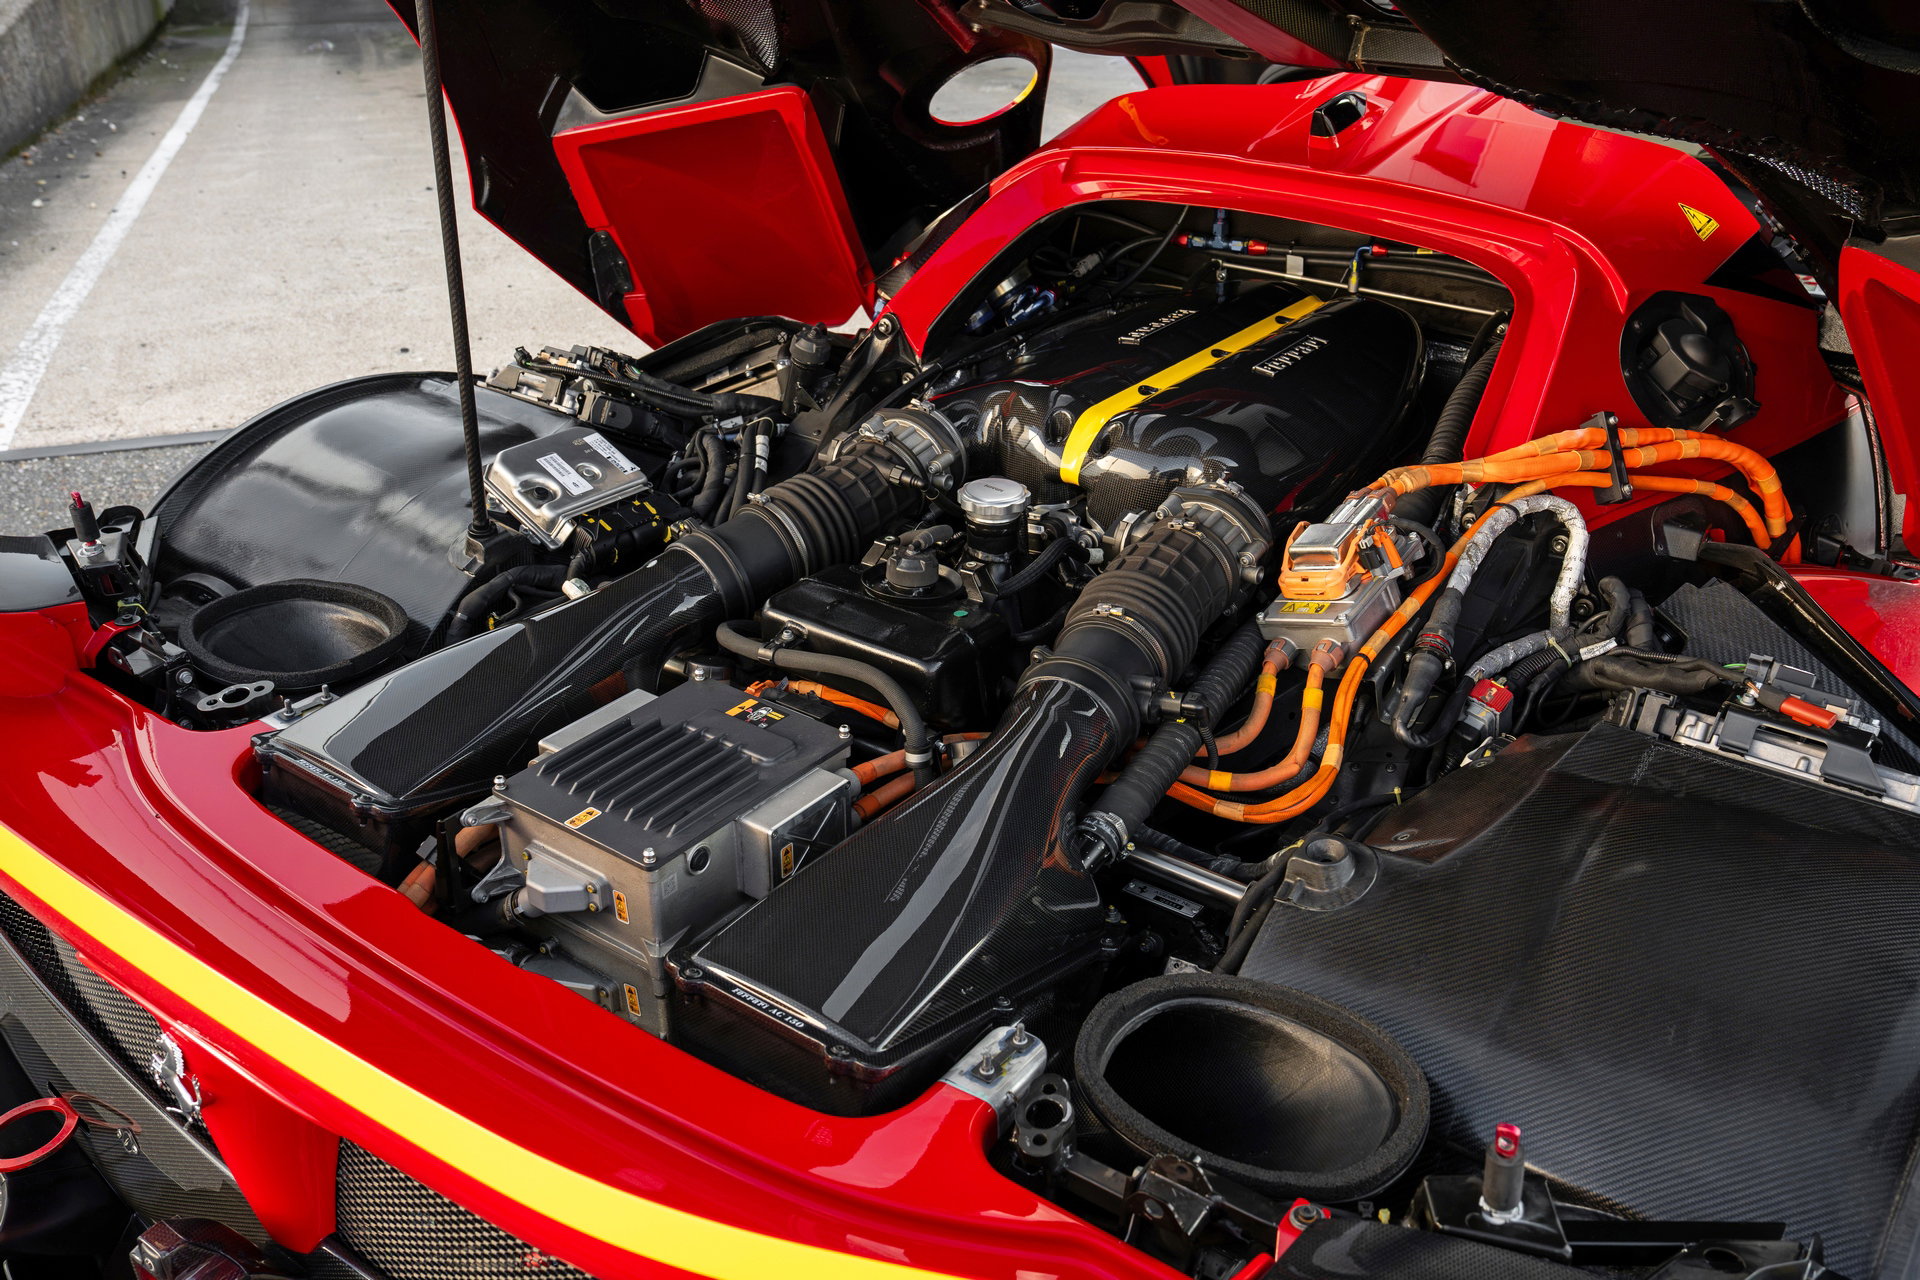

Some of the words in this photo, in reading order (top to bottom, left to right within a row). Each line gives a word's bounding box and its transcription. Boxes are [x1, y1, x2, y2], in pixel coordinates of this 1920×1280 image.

[1252, 334, 1328, 377] Ferrari
[731, 987, 770, 1009] Ferrari
[768, 1008, 786, 1018] AC
[784, 1015, 805, 1028] 150
